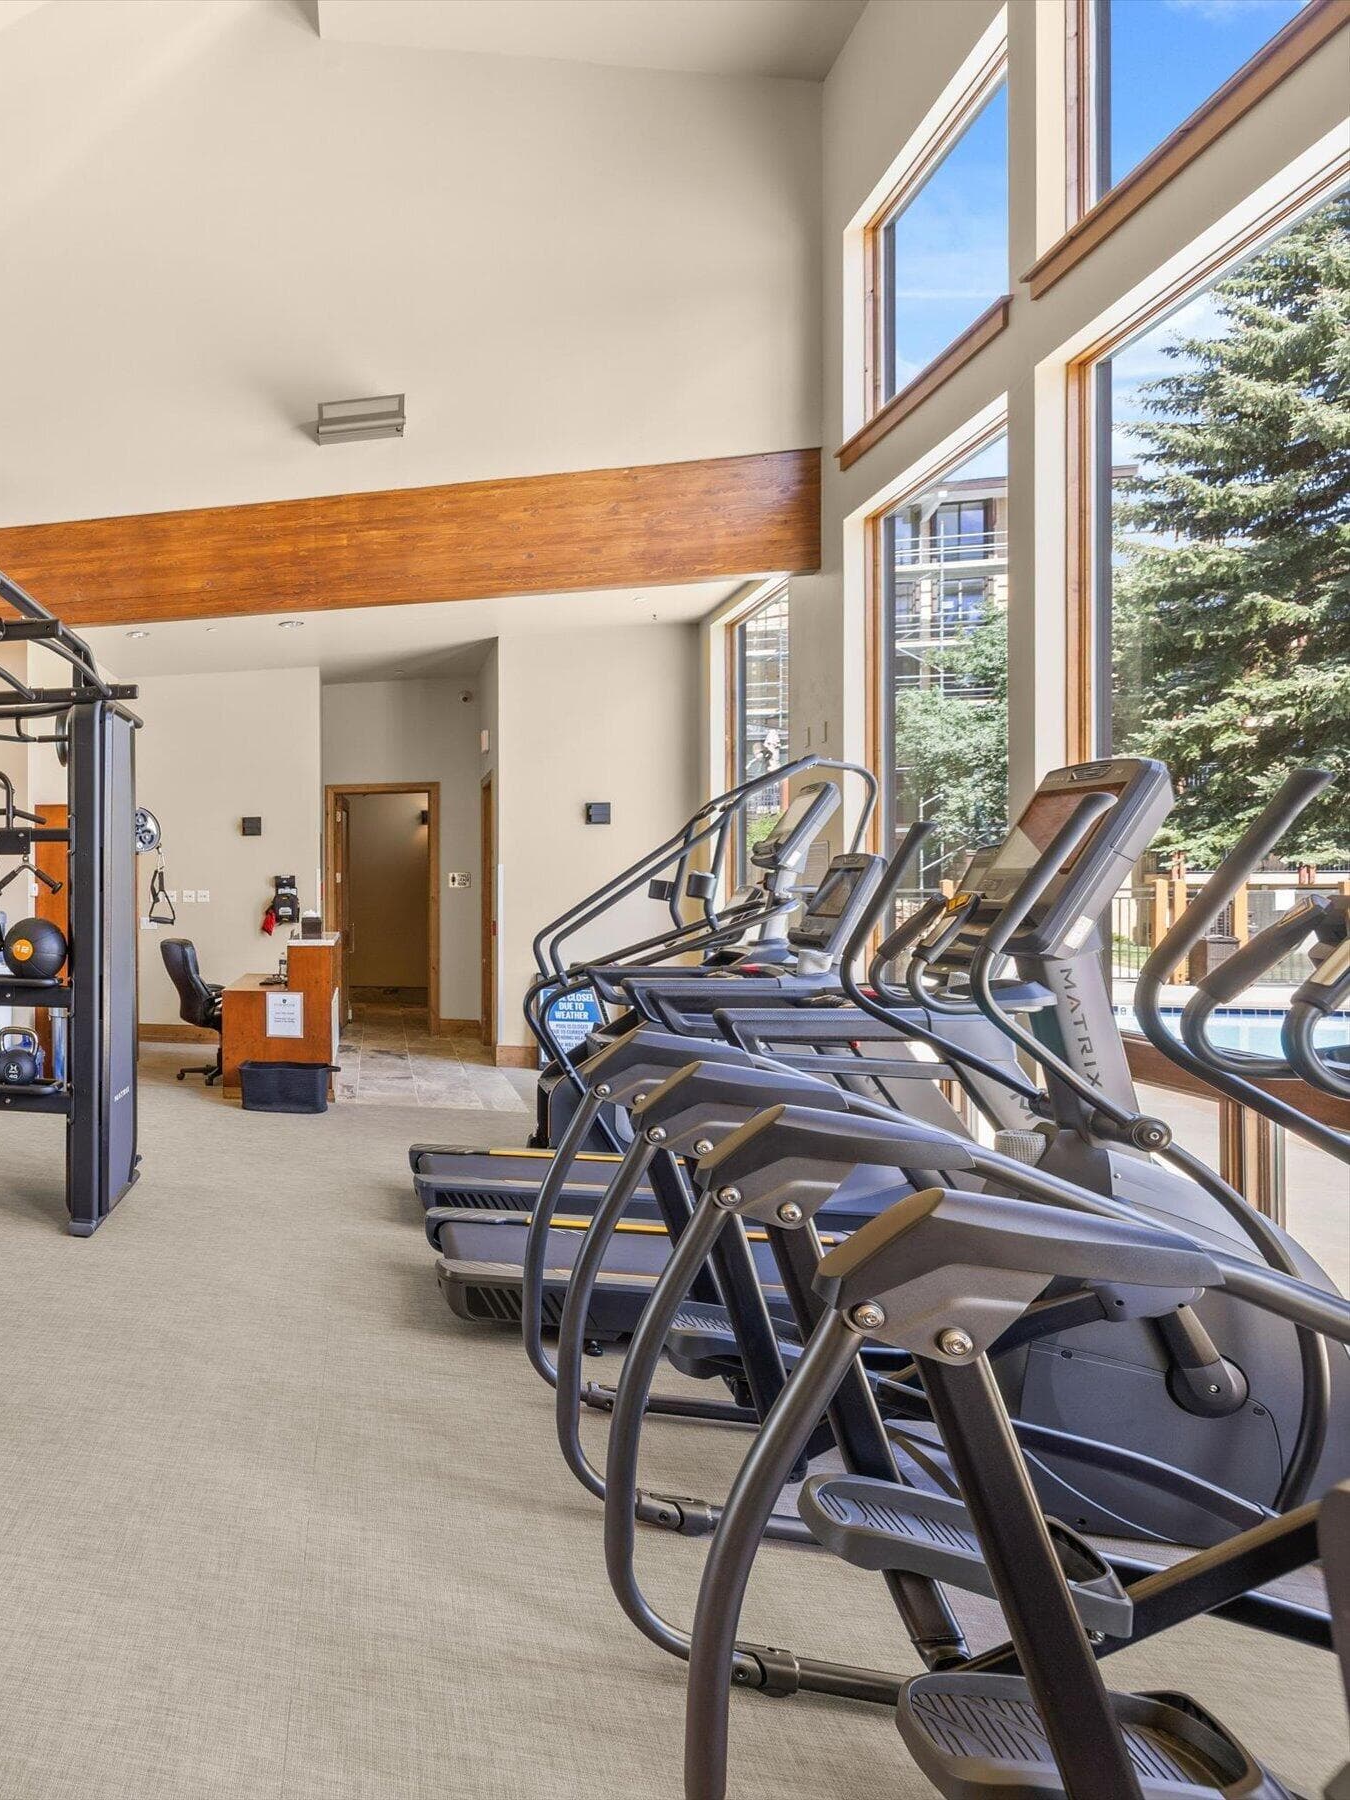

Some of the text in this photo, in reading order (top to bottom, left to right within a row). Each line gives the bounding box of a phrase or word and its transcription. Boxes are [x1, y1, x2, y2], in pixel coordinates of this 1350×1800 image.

[558, 1002, 585, 1011] DUE TO
[554, 1010, 589, 1020] WEATHER
[1060, 968, 1103, 1088] MATRIX
